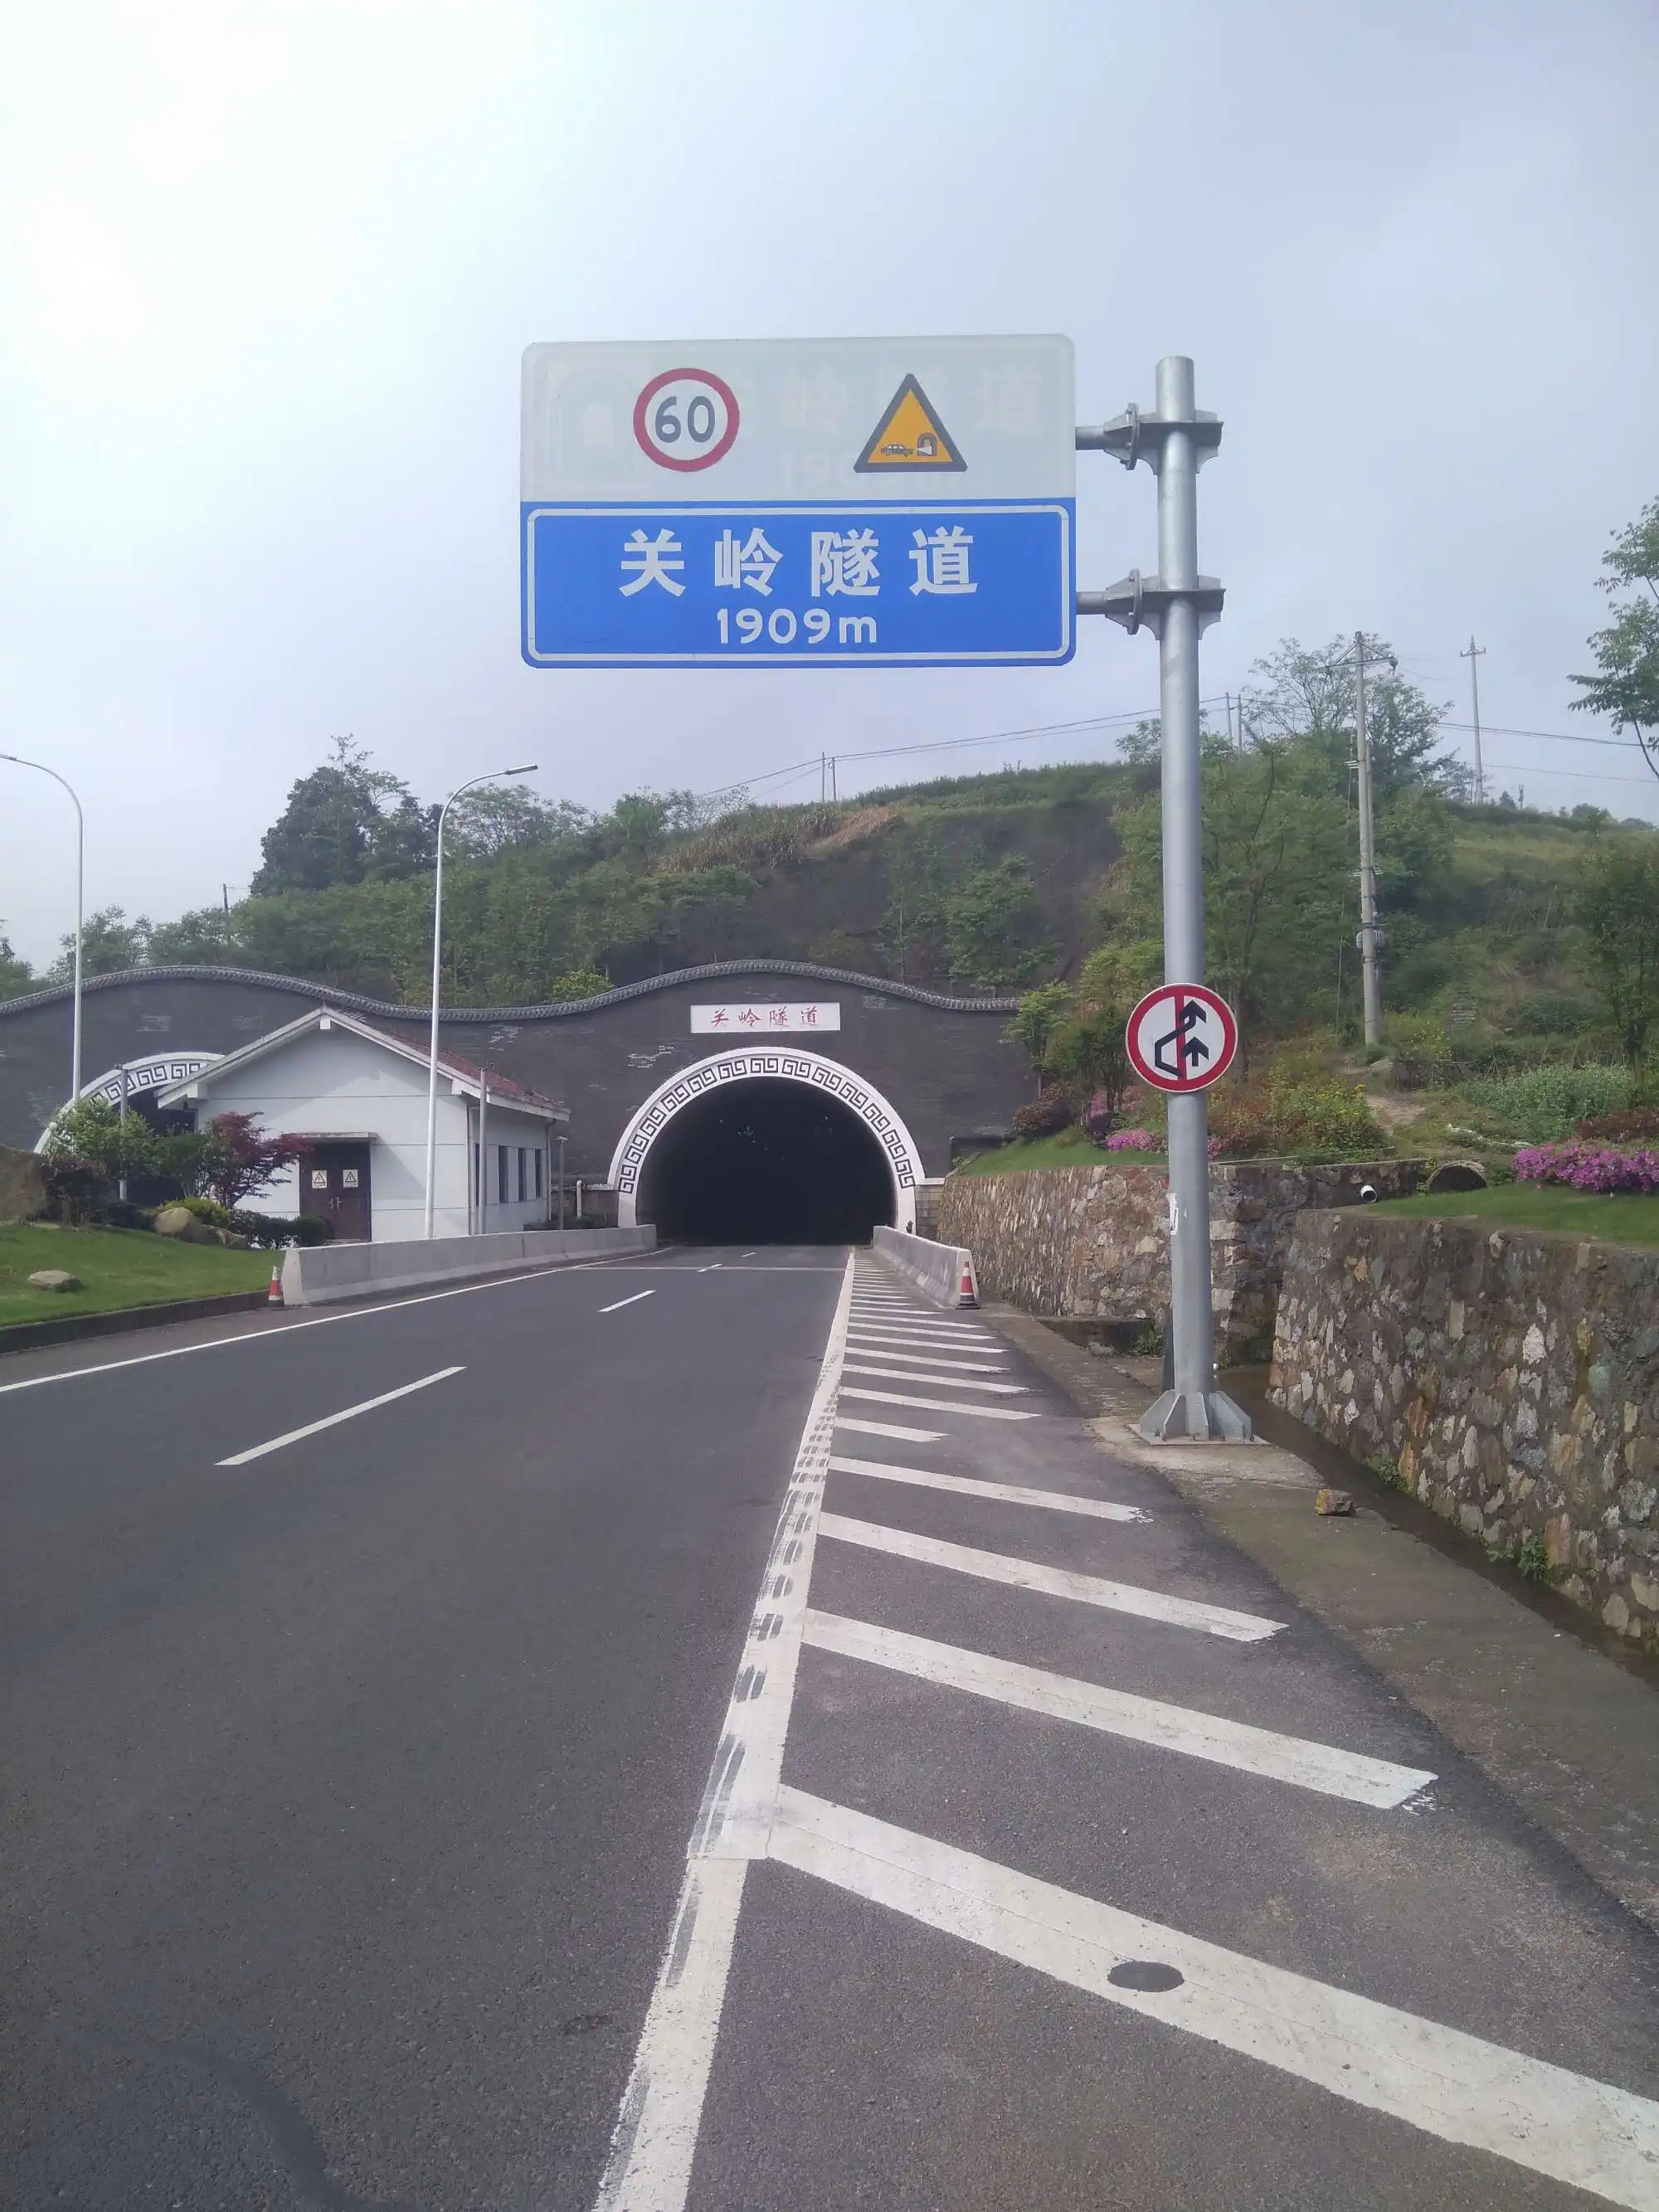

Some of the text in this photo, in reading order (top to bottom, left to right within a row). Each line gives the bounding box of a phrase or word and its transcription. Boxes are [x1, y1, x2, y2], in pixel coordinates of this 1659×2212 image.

[655, 396, 715, 443] 60
[619, 525, 978, 597] 关岭隧道
[717, 608, 877, 644] 1909m
[711, 1005, 820, 1028] 关岭隧道
